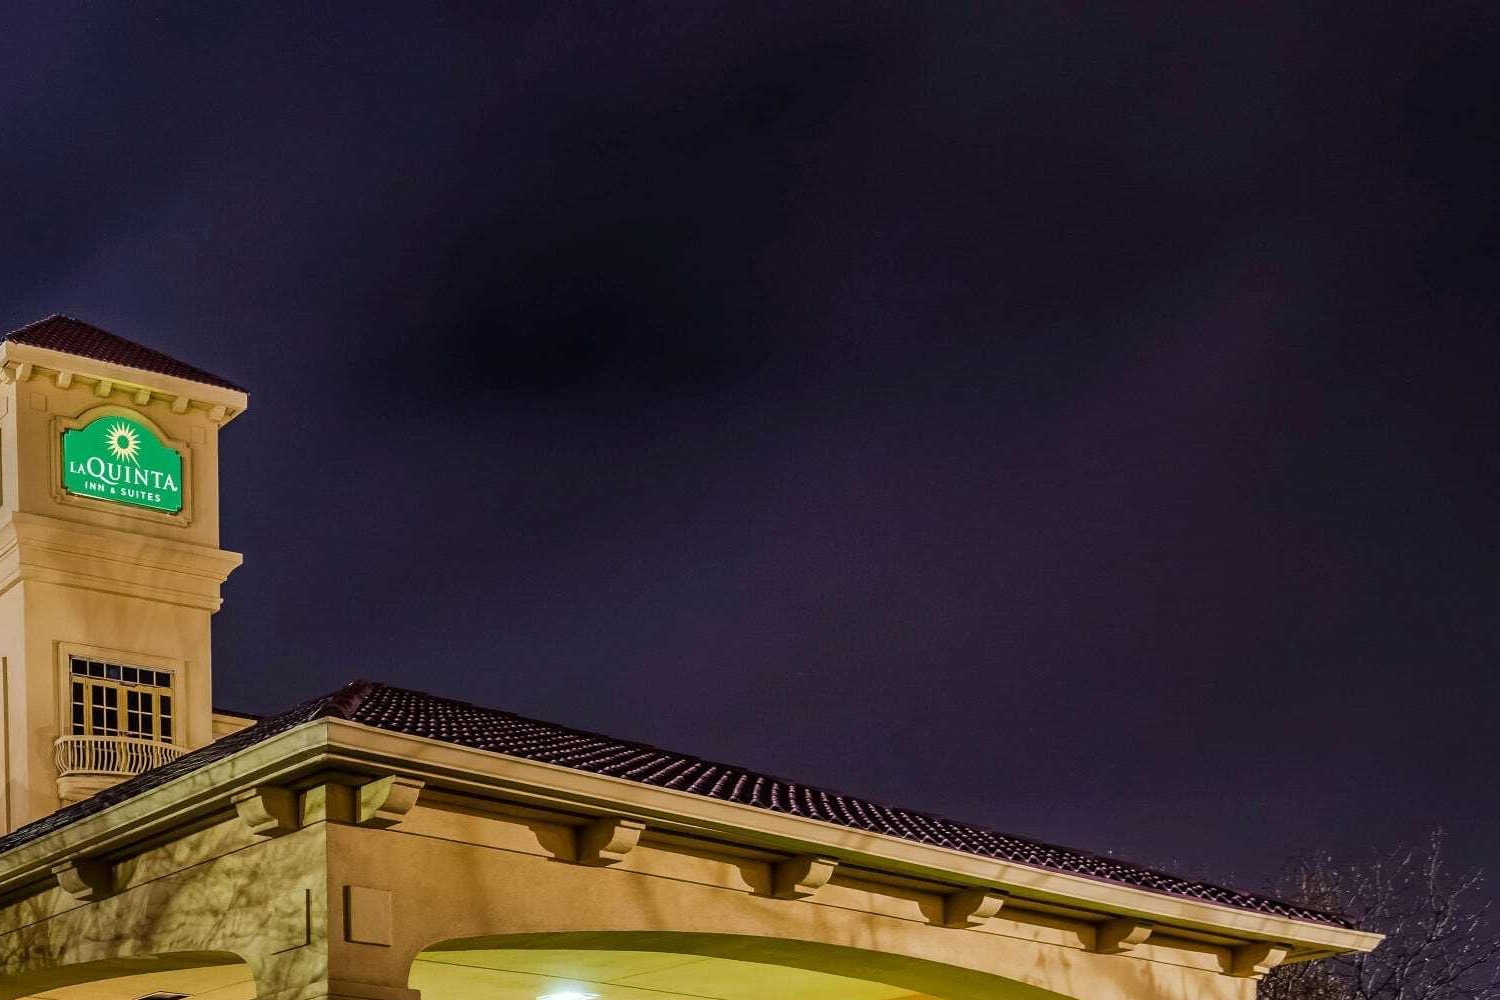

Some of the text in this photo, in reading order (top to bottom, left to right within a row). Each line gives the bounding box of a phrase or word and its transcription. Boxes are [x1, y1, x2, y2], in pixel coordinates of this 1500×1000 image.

[70, 456, 178, 492] LA QUINTA
[84, 481, 105, 492] INN
[120, 488, 161, 503] SUITES
